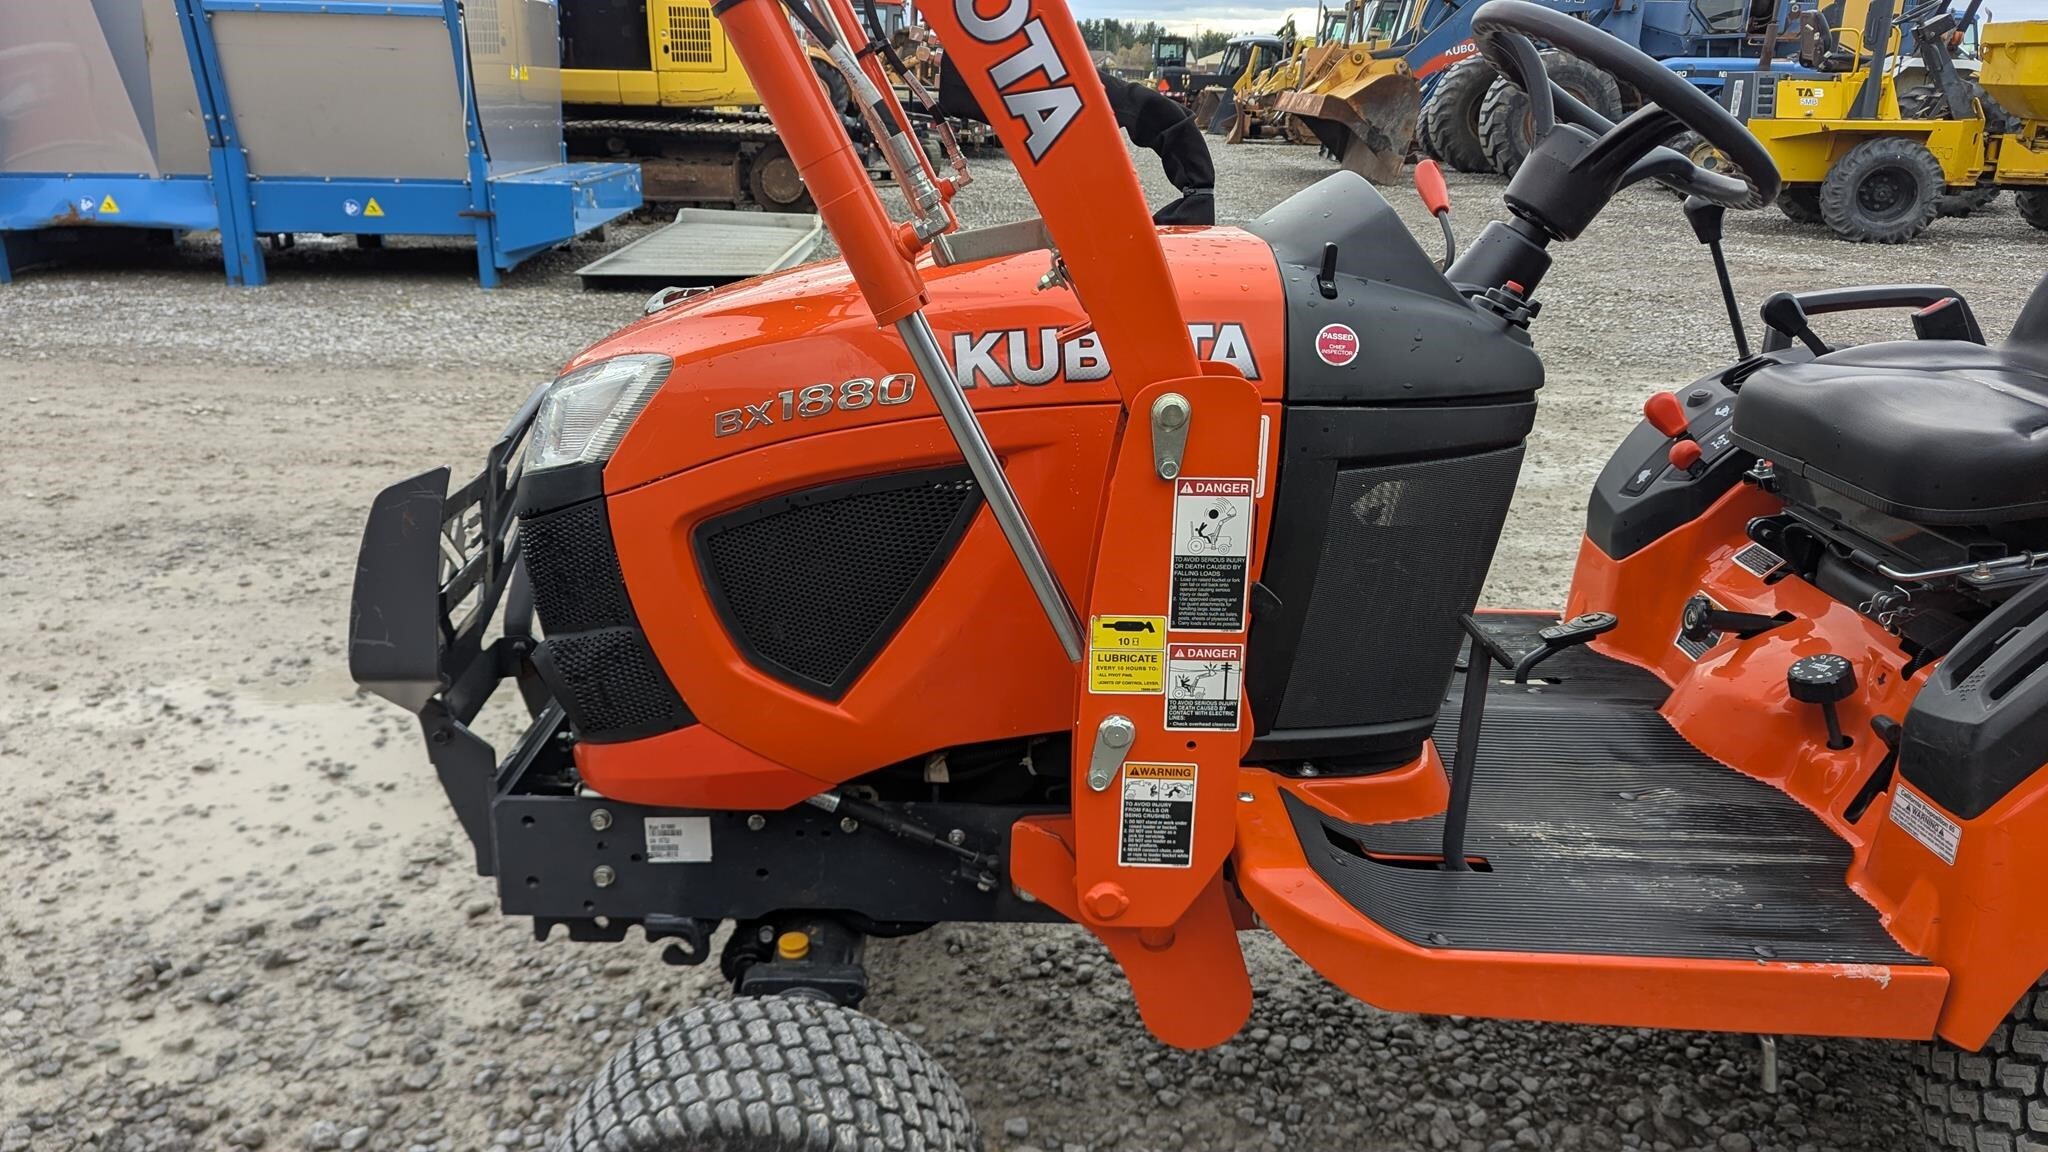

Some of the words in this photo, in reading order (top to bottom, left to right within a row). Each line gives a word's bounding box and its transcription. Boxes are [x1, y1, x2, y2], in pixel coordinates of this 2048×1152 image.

[1322, 332, 1354, 341] PASSED
[714, 372, 917, 439] BX1880
[1196, 483, 1249, 493] DANGER
[1118, 637, 1130, 646] 10
[1187, 648, 1238, 658] DANGER
[1097, 654, 1158, 663] LUBRICATE
[1140, 767, 1191, 777] WARNING
[1900, 790, 1922, 809] California
[1922, 805, 1949, 828] Proposition
[1948, 824, 1956, 833] 65
[1912, 807, 1940, 832] WARNING
